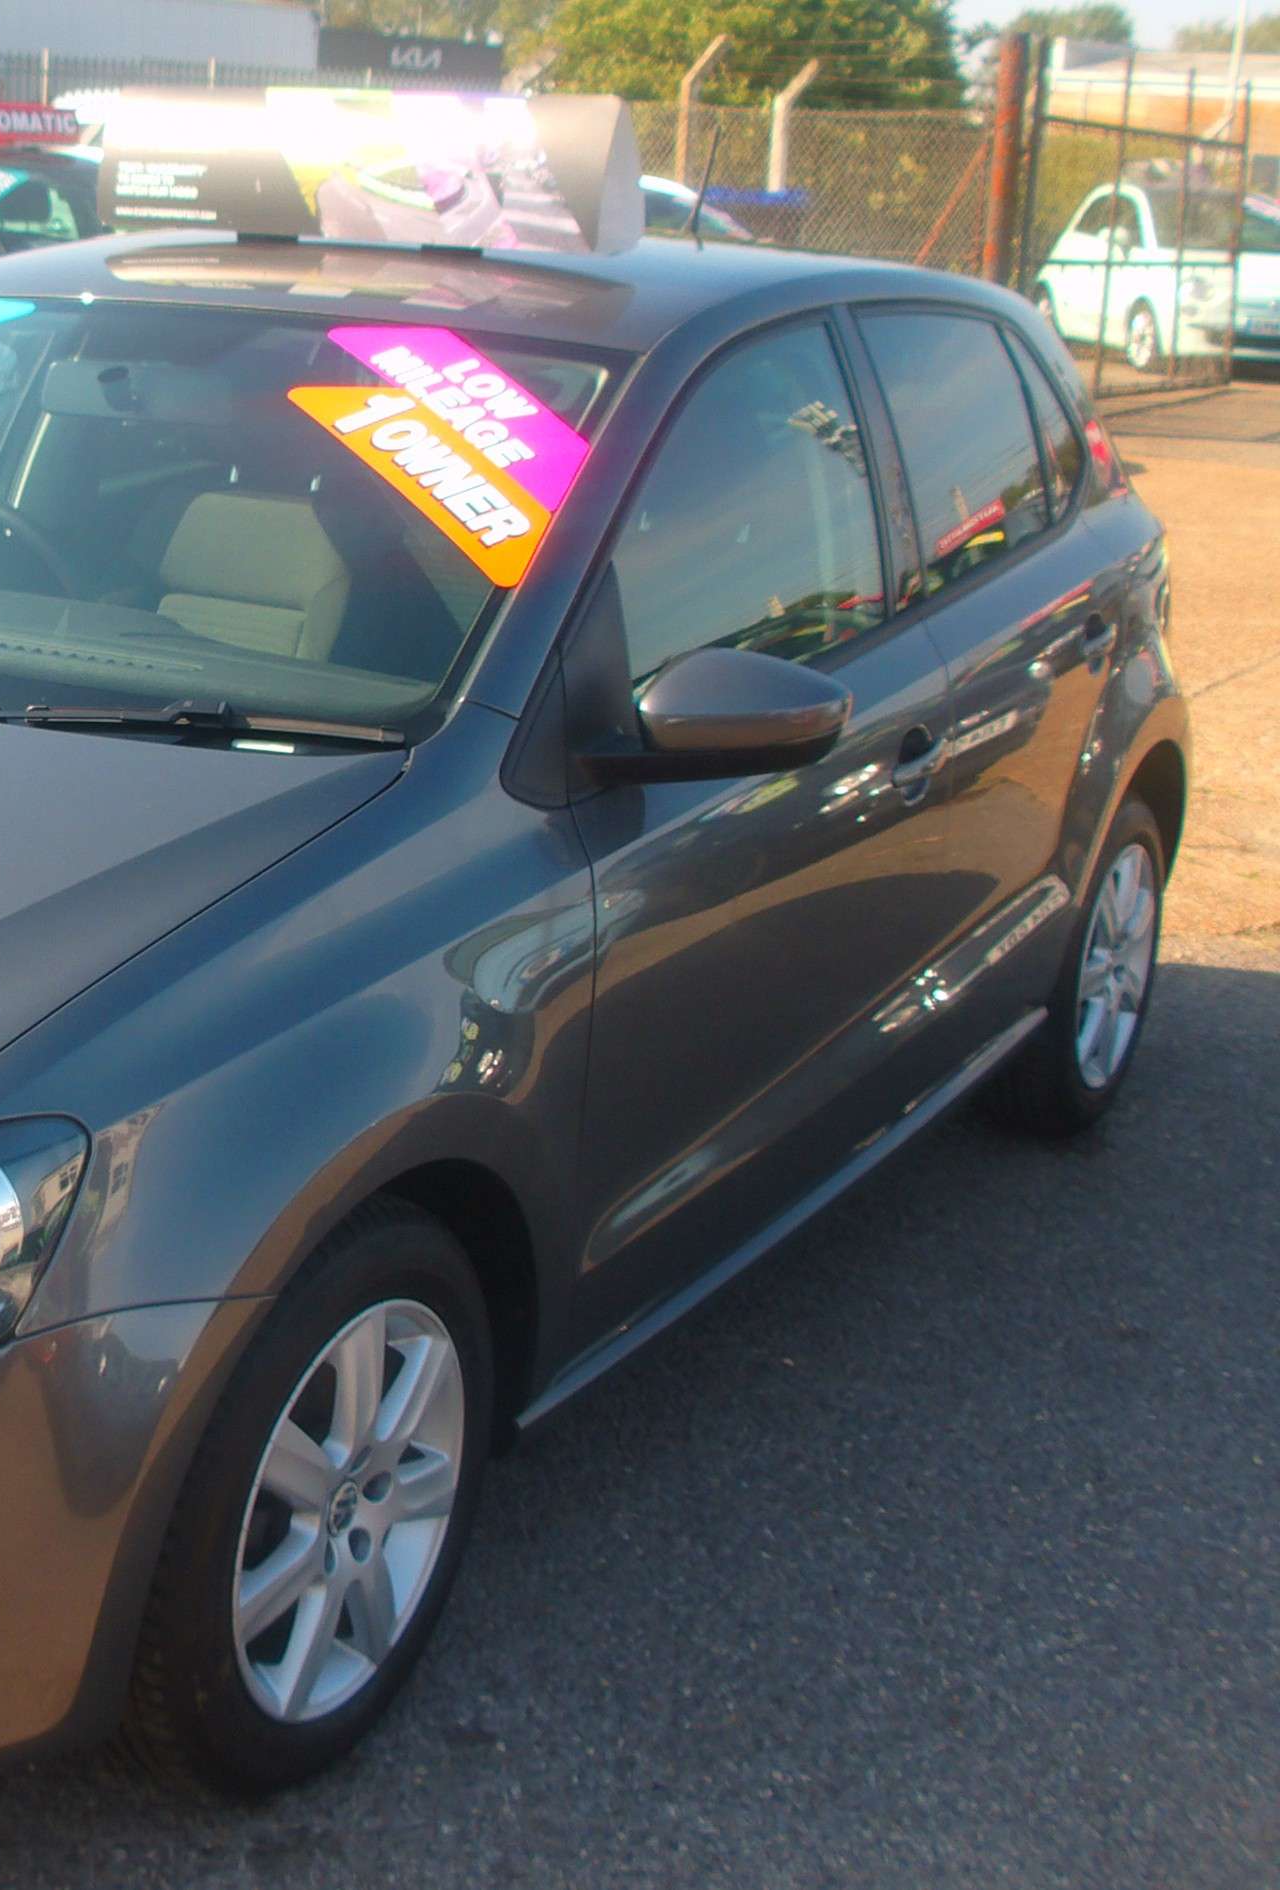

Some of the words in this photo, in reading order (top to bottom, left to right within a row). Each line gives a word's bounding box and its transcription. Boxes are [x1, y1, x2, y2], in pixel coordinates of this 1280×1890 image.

[390, 47, 442, 68] KIA
[333, 393, 417, 435] 1
[370, 346, 536, 468] MILEAGE
[441, 358, 539, 420] LOW
[370, 419, 532, 549] OWNER
